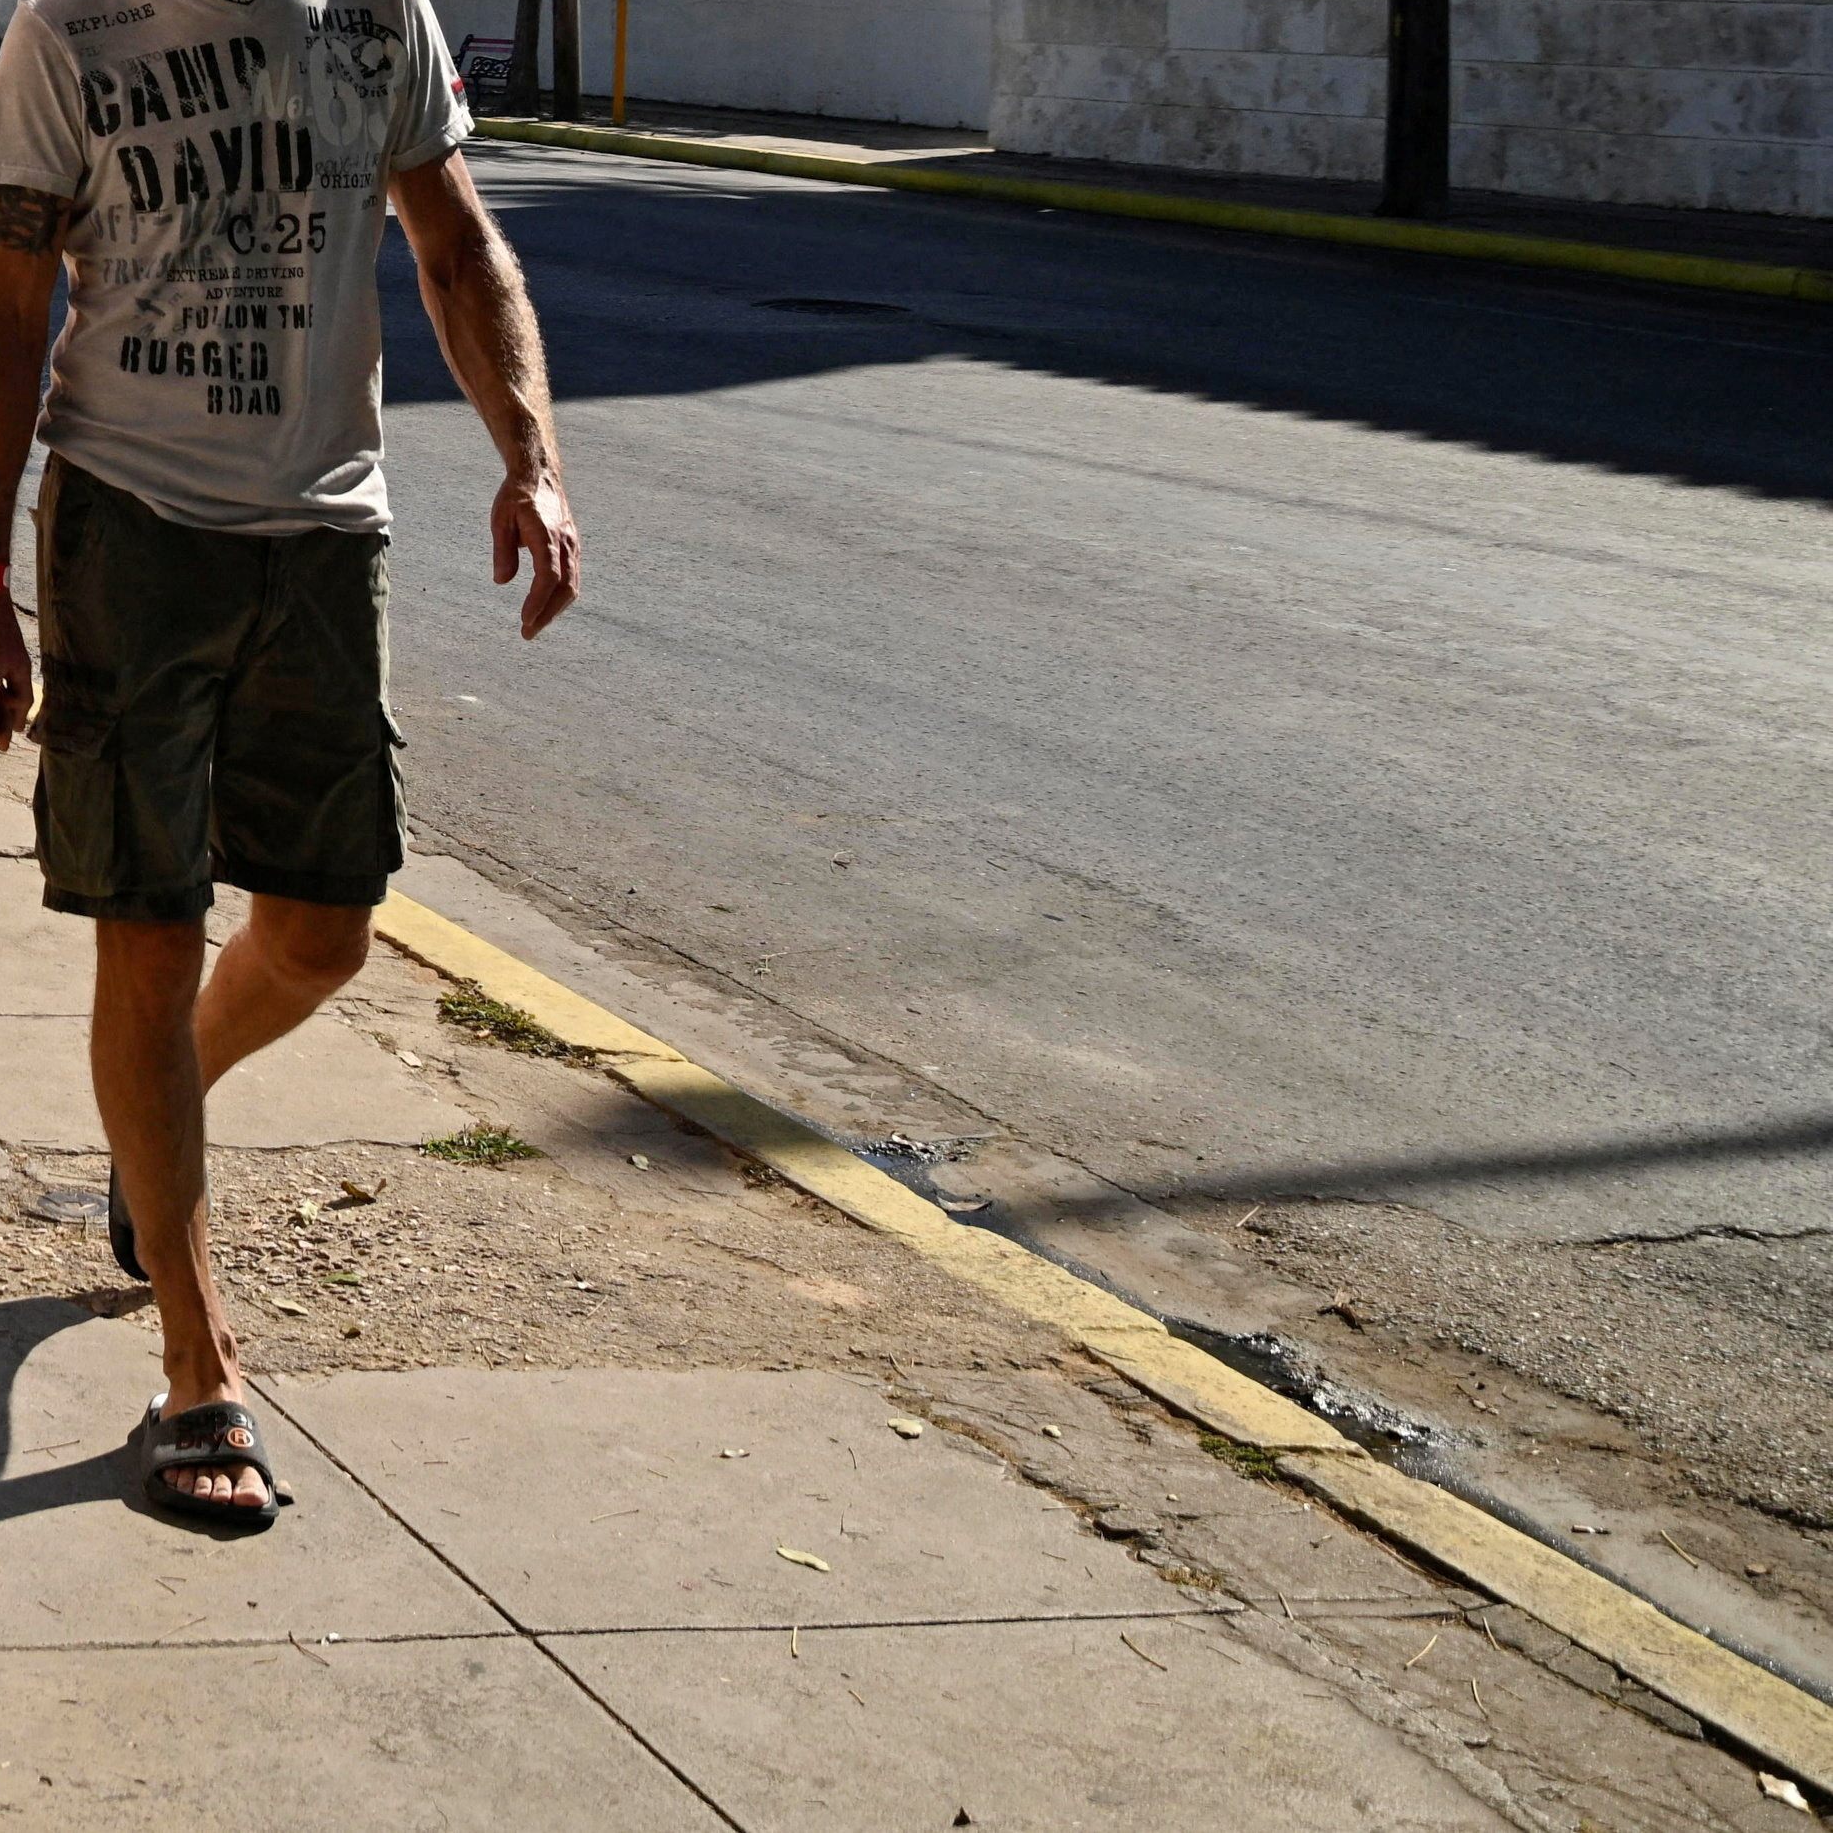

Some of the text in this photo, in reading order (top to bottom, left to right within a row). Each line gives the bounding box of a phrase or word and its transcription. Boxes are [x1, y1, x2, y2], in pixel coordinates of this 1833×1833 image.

[64, 3, 155, 36] EXPLORE
[79, 36, 266, 137] CAMP
[117, 120, 313, 213] DAVID
[227, 211, 327, 255] C.25
[165, 266, 305, 283] EXTREME DRIVING
[205, 286, 283, 301] ADVENTURE
[182, 304, 268, 331] FOLLOW
[119, 334, 269, 382] RUGGED
[206, 384, 282, 416] ROAD
